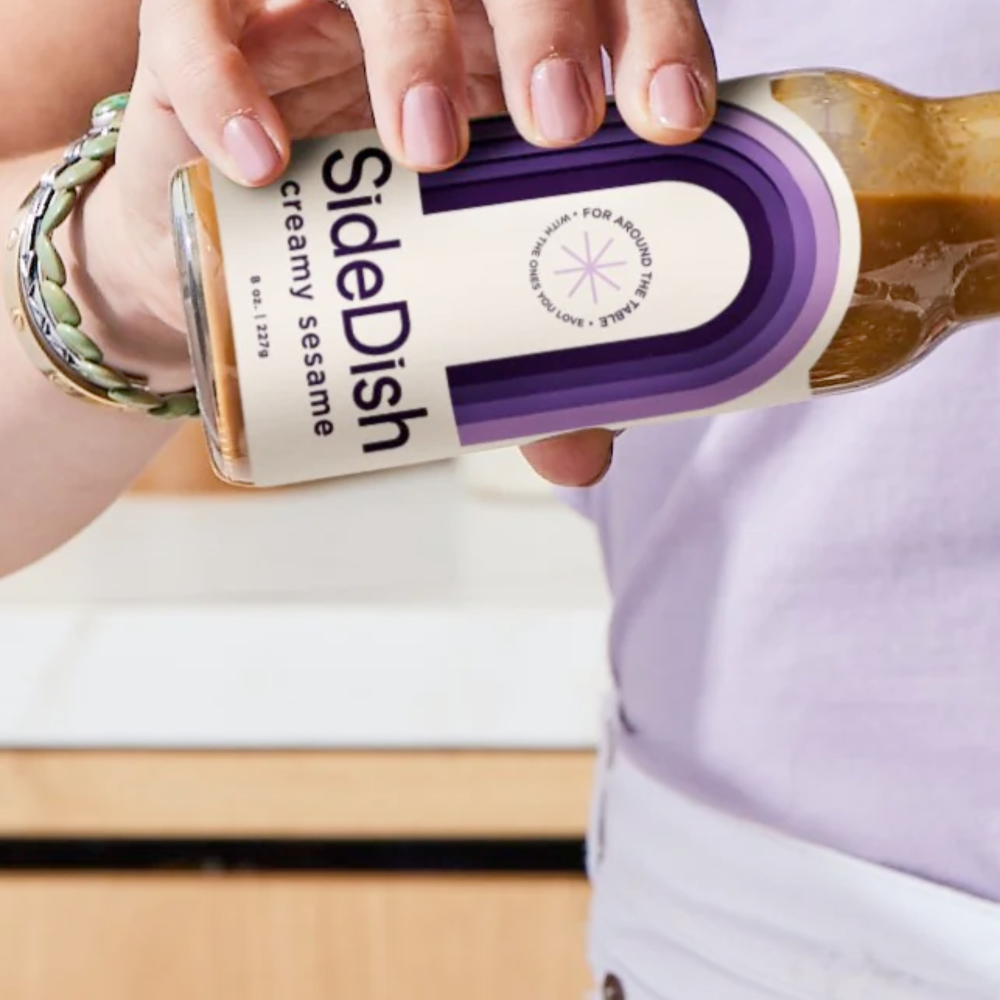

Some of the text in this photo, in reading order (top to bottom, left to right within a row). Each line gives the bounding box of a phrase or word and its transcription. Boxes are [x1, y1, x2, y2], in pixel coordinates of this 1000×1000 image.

[250, 275, 261, 284] 8
[256, 323, 270, 358] 227g
[279, 179, 334, 437] creamy sesame
[321, 146, 428, 453] SideDish
[529, 213, 585, 327] WITH THE ONES YOU LOVE
[582, 207, 652, 327] FOR AROUND THE TABLE
